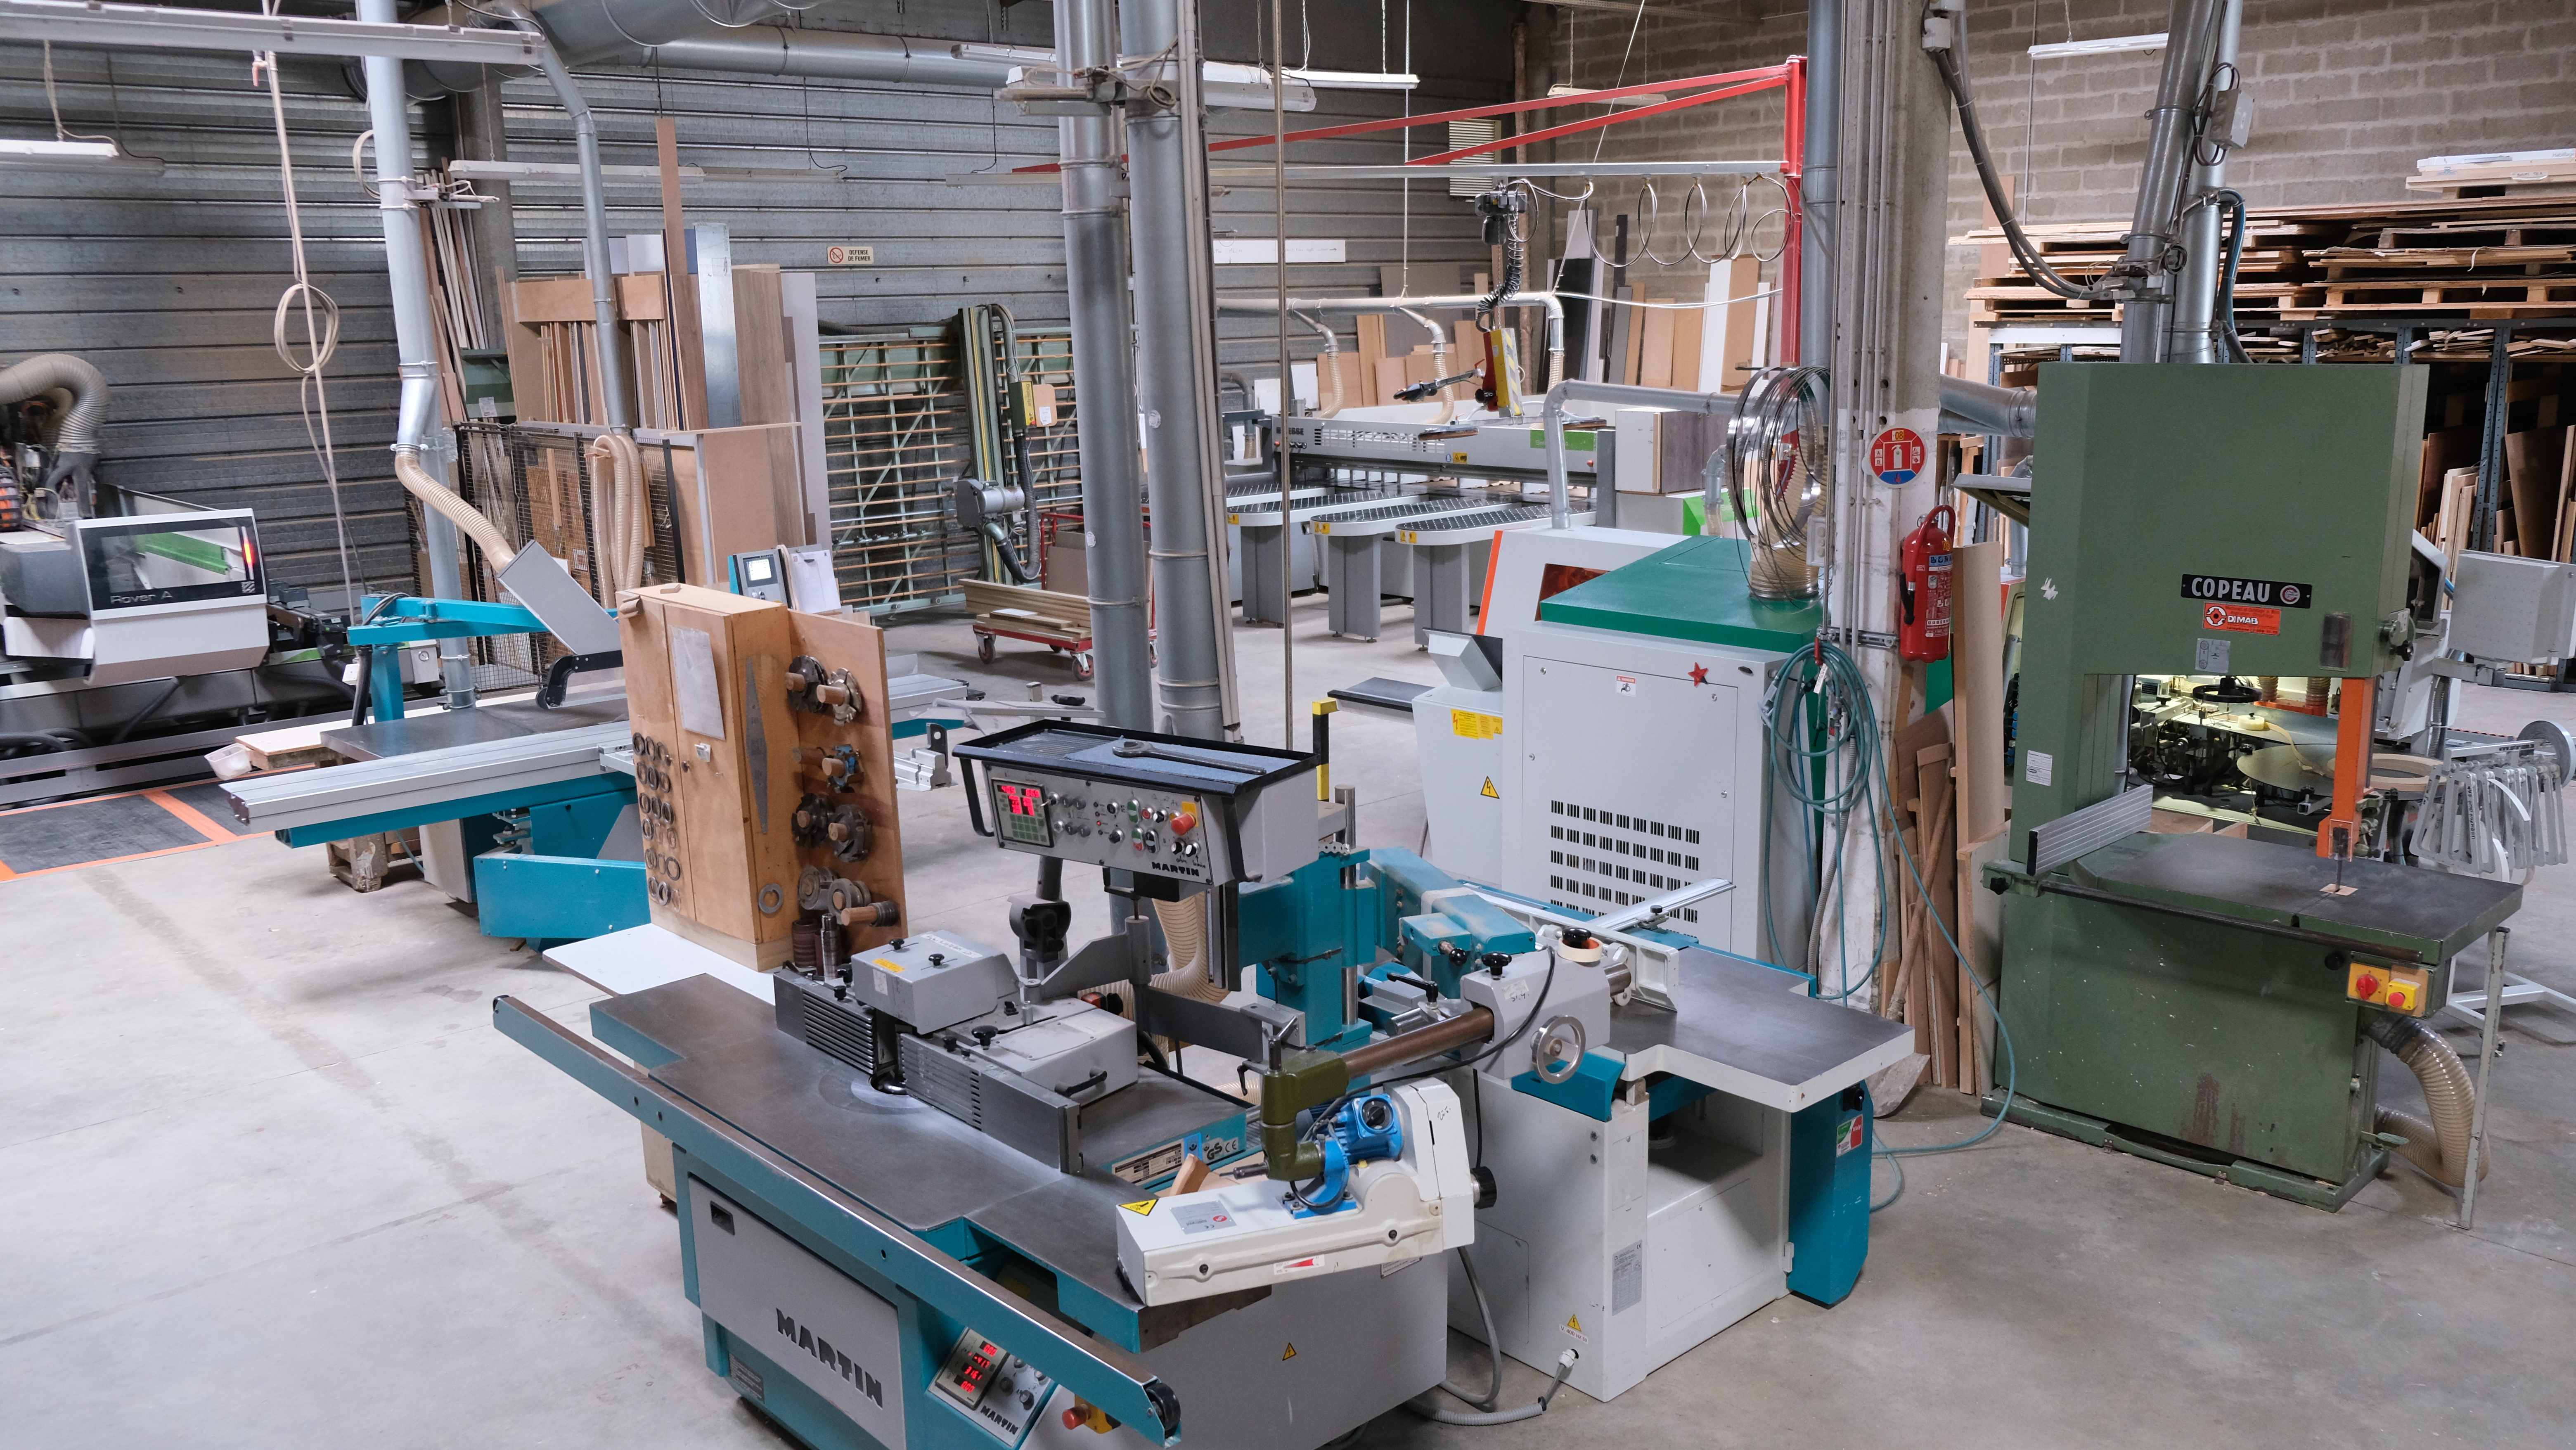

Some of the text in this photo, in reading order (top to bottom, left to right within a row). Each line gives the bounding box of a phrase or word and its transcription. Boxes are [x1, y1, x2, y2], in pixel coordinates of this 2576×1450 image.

[1895, 431, 1903, 440] 08
[110, 591, 173, 604] Rover A
[2191, 578, 2270, 602] COPEAU
[1151, 862, 1199, 877] MARTIN
[1207, 1140, 1237, 1160] GS CE
[776, 1308, 883, 1409] MARTIN
[980, 1405, 1018, 1435] MARTIN
